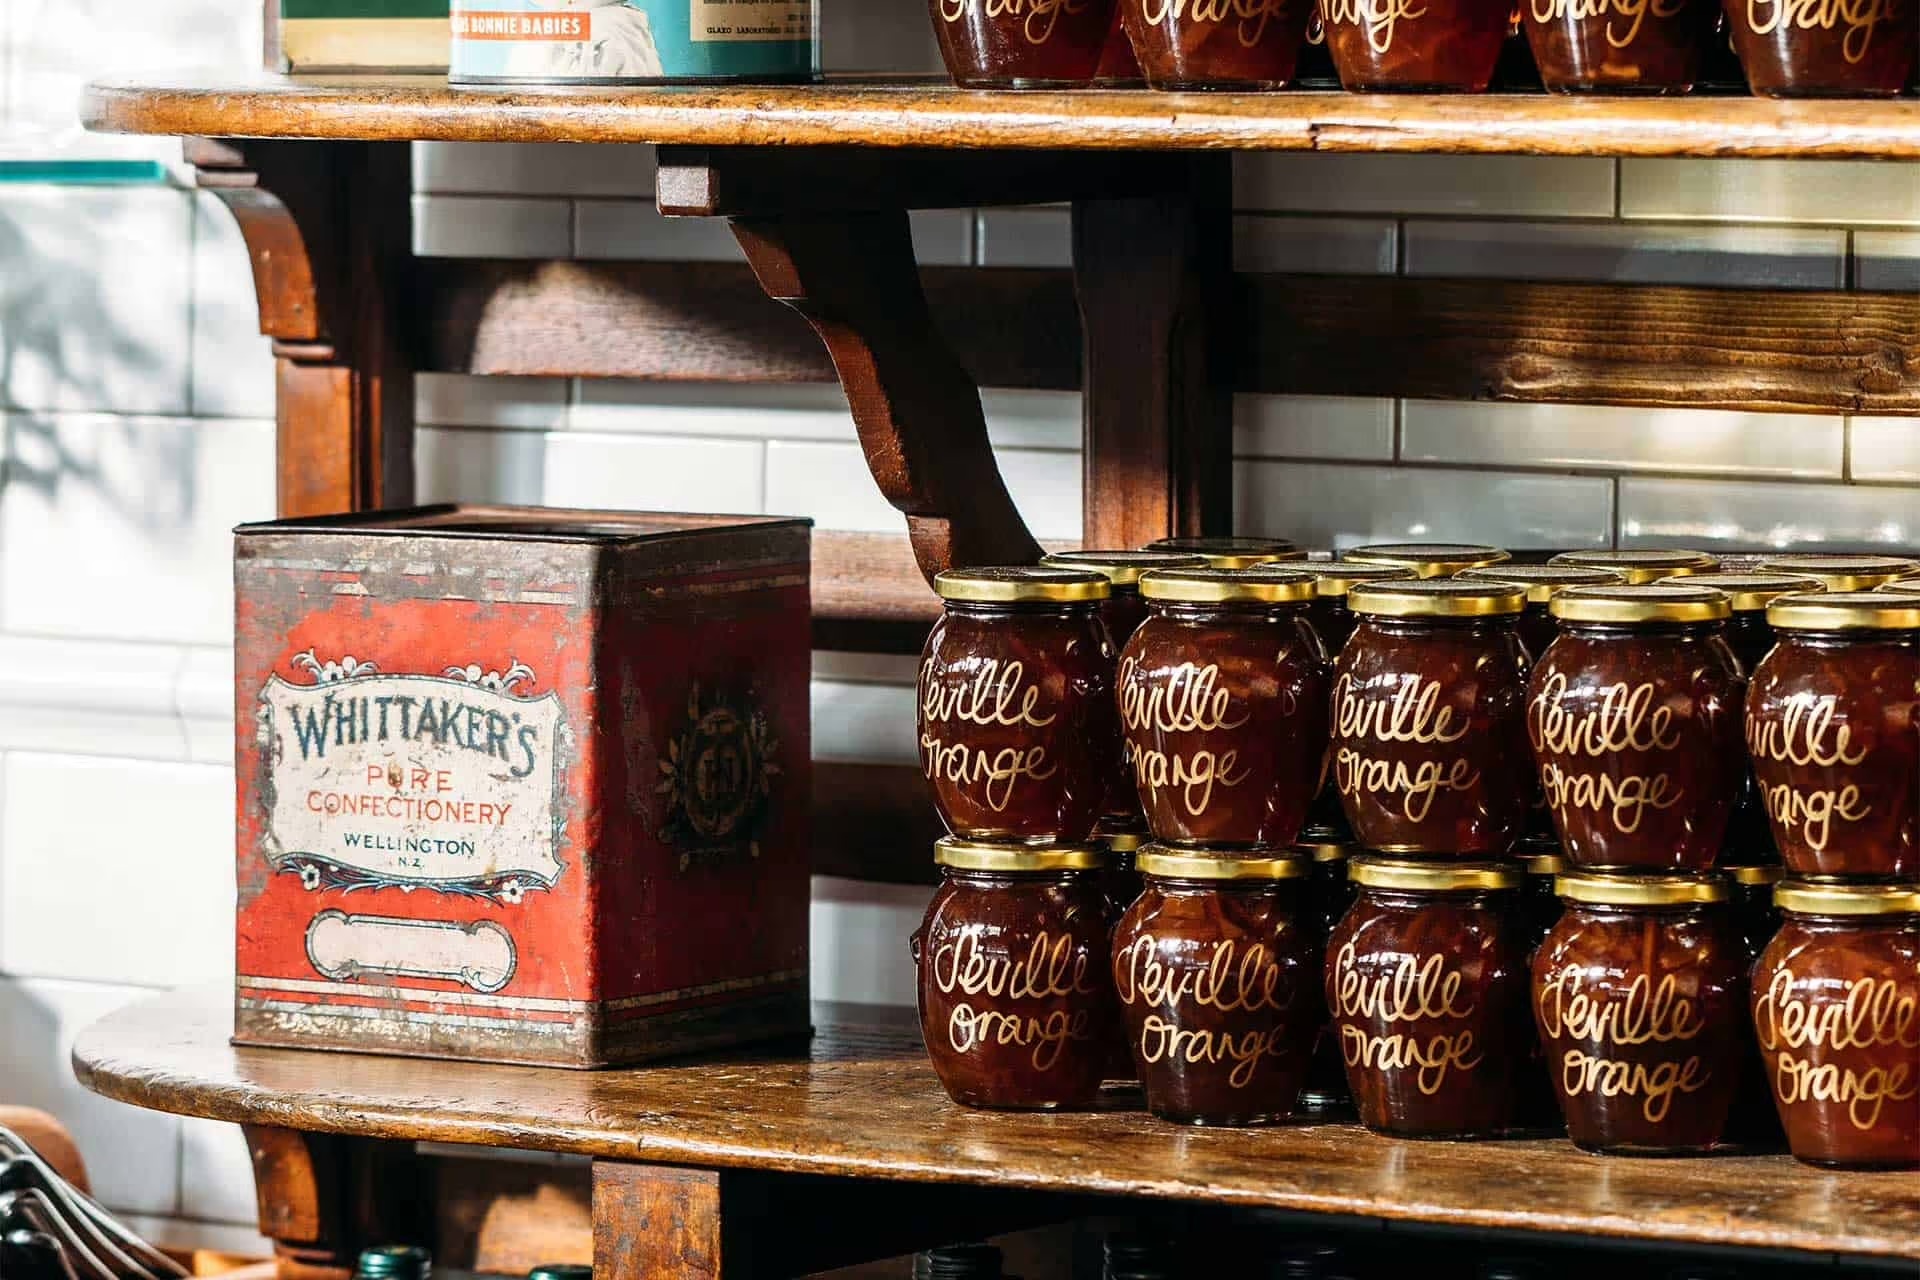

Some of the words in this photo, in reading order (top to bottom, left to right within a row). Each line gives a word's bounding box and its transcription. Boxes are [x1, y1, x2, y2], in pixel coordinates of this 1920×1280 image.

[471, 16, 517, 34] BONNIE
[521, 17, 581, 35] BABIES
[286, 691, 538, 778] WHITTAKER'S
[366, 764, 454, 791] PURE
[306, 789, 513, 826] CONFECTIONERY
[343, 832, 475, 857] WELLINGTON
[398, 856, 425, 869] N.Z.
